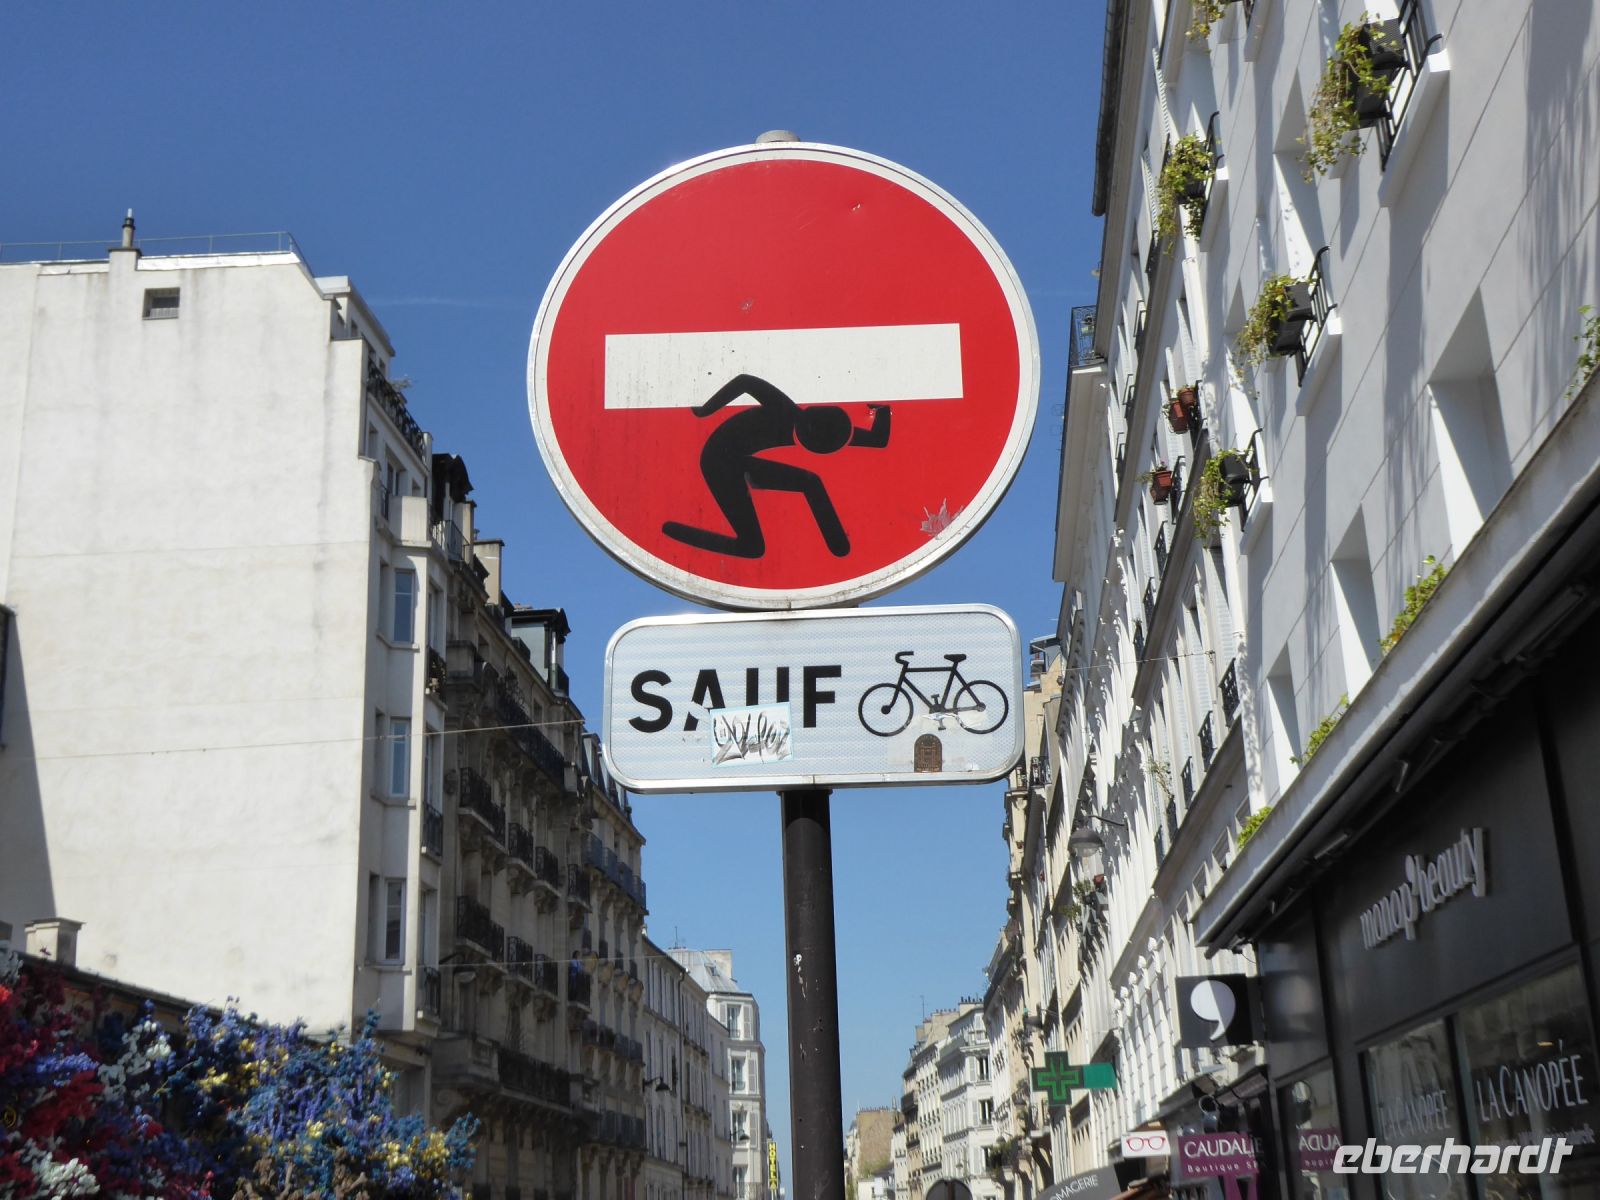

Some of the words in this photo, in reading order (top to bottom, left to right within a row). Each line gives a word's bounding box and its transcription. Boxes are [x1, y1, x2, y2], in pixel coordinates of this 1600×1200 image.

[1476, 1079, 1501, 1122] LA
[769, 1142, 777, 1179] HOTEL
[1187, 1163, 1239, 1174] Boutique
